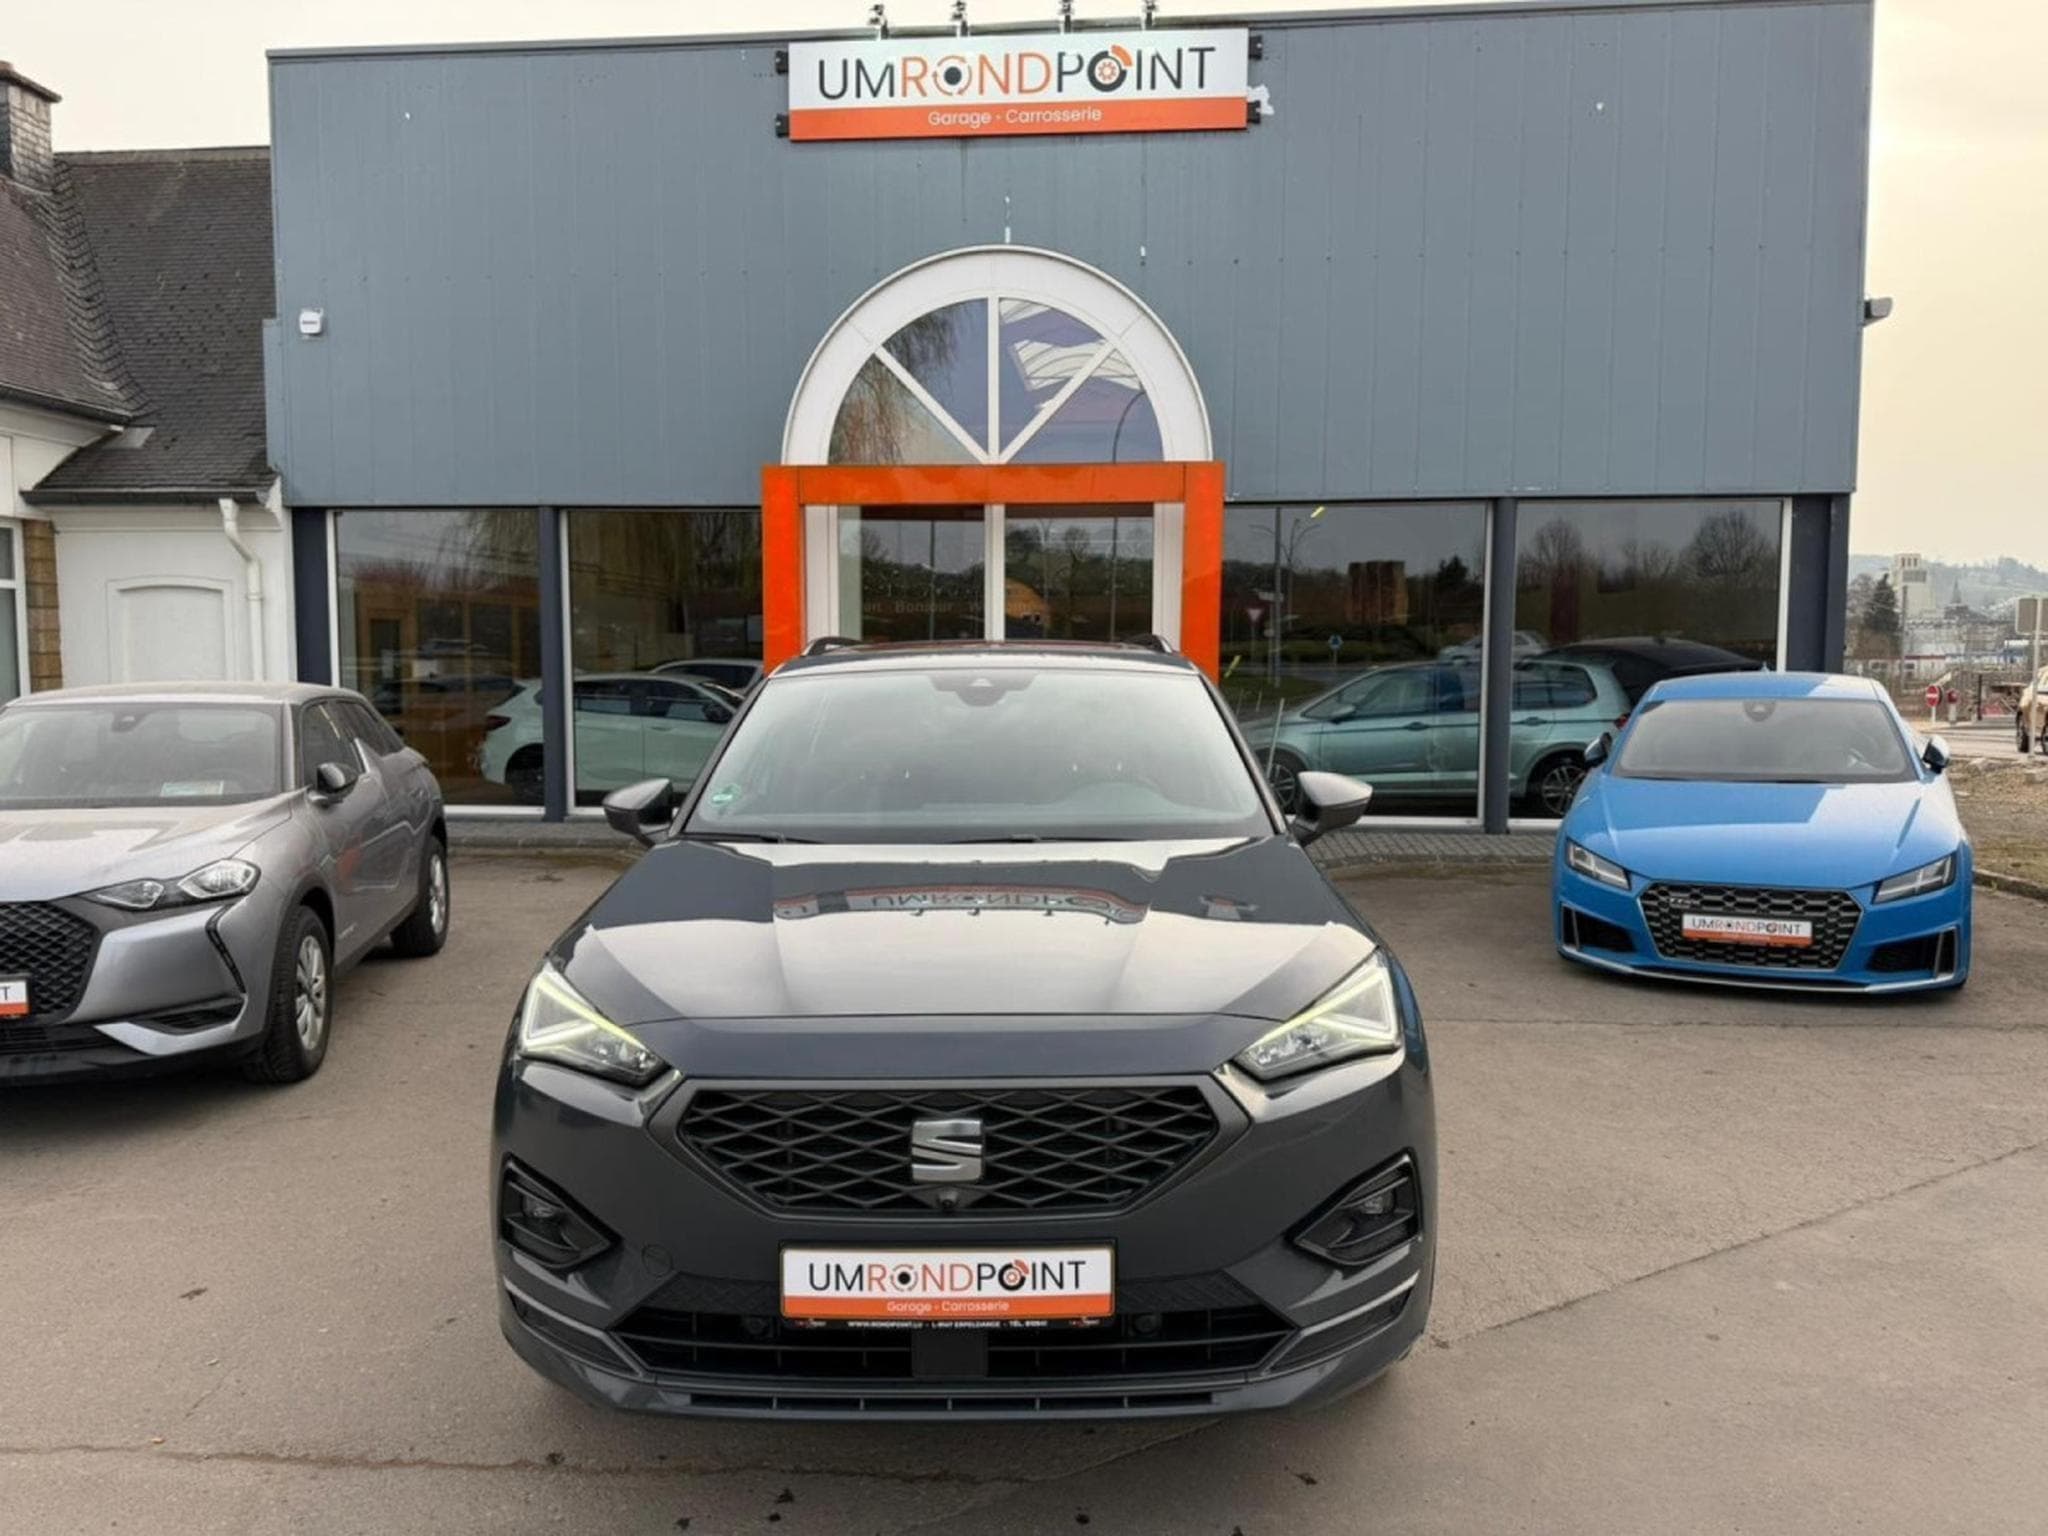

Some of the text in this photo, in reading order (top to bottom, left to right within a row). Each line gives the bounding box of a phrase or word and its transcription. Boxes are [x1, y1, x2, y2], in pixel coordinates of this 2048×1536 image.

[818, 45, 1216, 99] UMRONDPOINT
[927, 110, 991, 129] Garage
[1005, 107, 1102, 124] Carrosserie
[808, 1259, 1086, 1291] UMRONDPOINT
[886, 1301, 932, 1313] Garage
[941, 1300, 1009, 1312] Carrosserie
